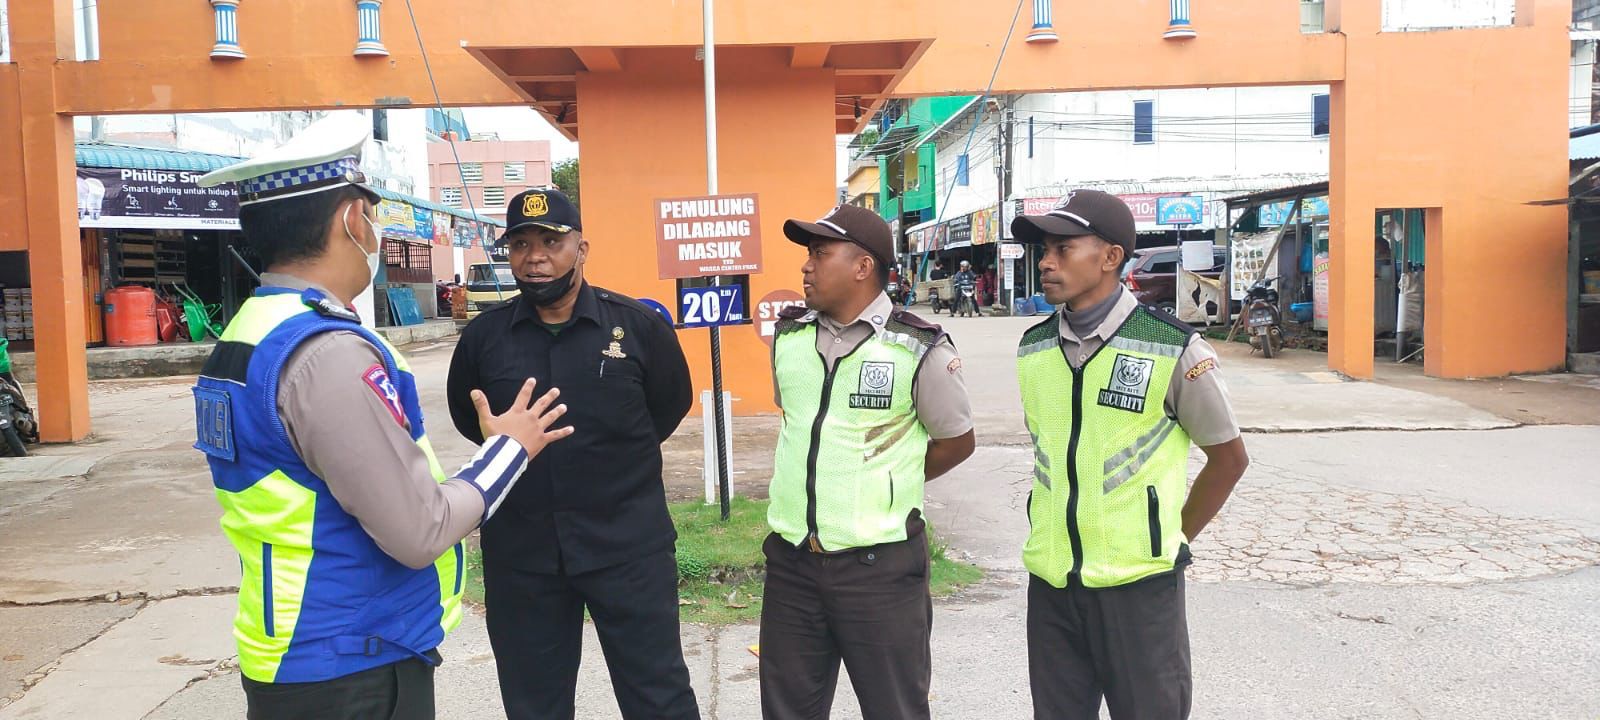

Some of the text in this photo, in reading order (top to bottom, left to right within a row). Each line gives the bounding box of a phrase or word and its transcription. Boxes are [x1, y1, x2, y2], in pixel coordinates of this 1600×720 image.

[121, 169, 176, 184] Philips
[122, 184, 149, 193] Smart
[150, 185, 182, 196] lighting
[183, 187, 207, 195] untuk
[208, 188, 230, 197] hidup
[661, 198, 754, 219] PEMULUNG
[1025, 201, 1054, 211] Inter
[663, 220, 750, 240] DILARANG
[679, 241, 742, 260] MASUK
[683, 290, 721, 323] 20
[850, 395, 890, 408] SECURITY
[1099, 390, 1145, 411] SECURITY
